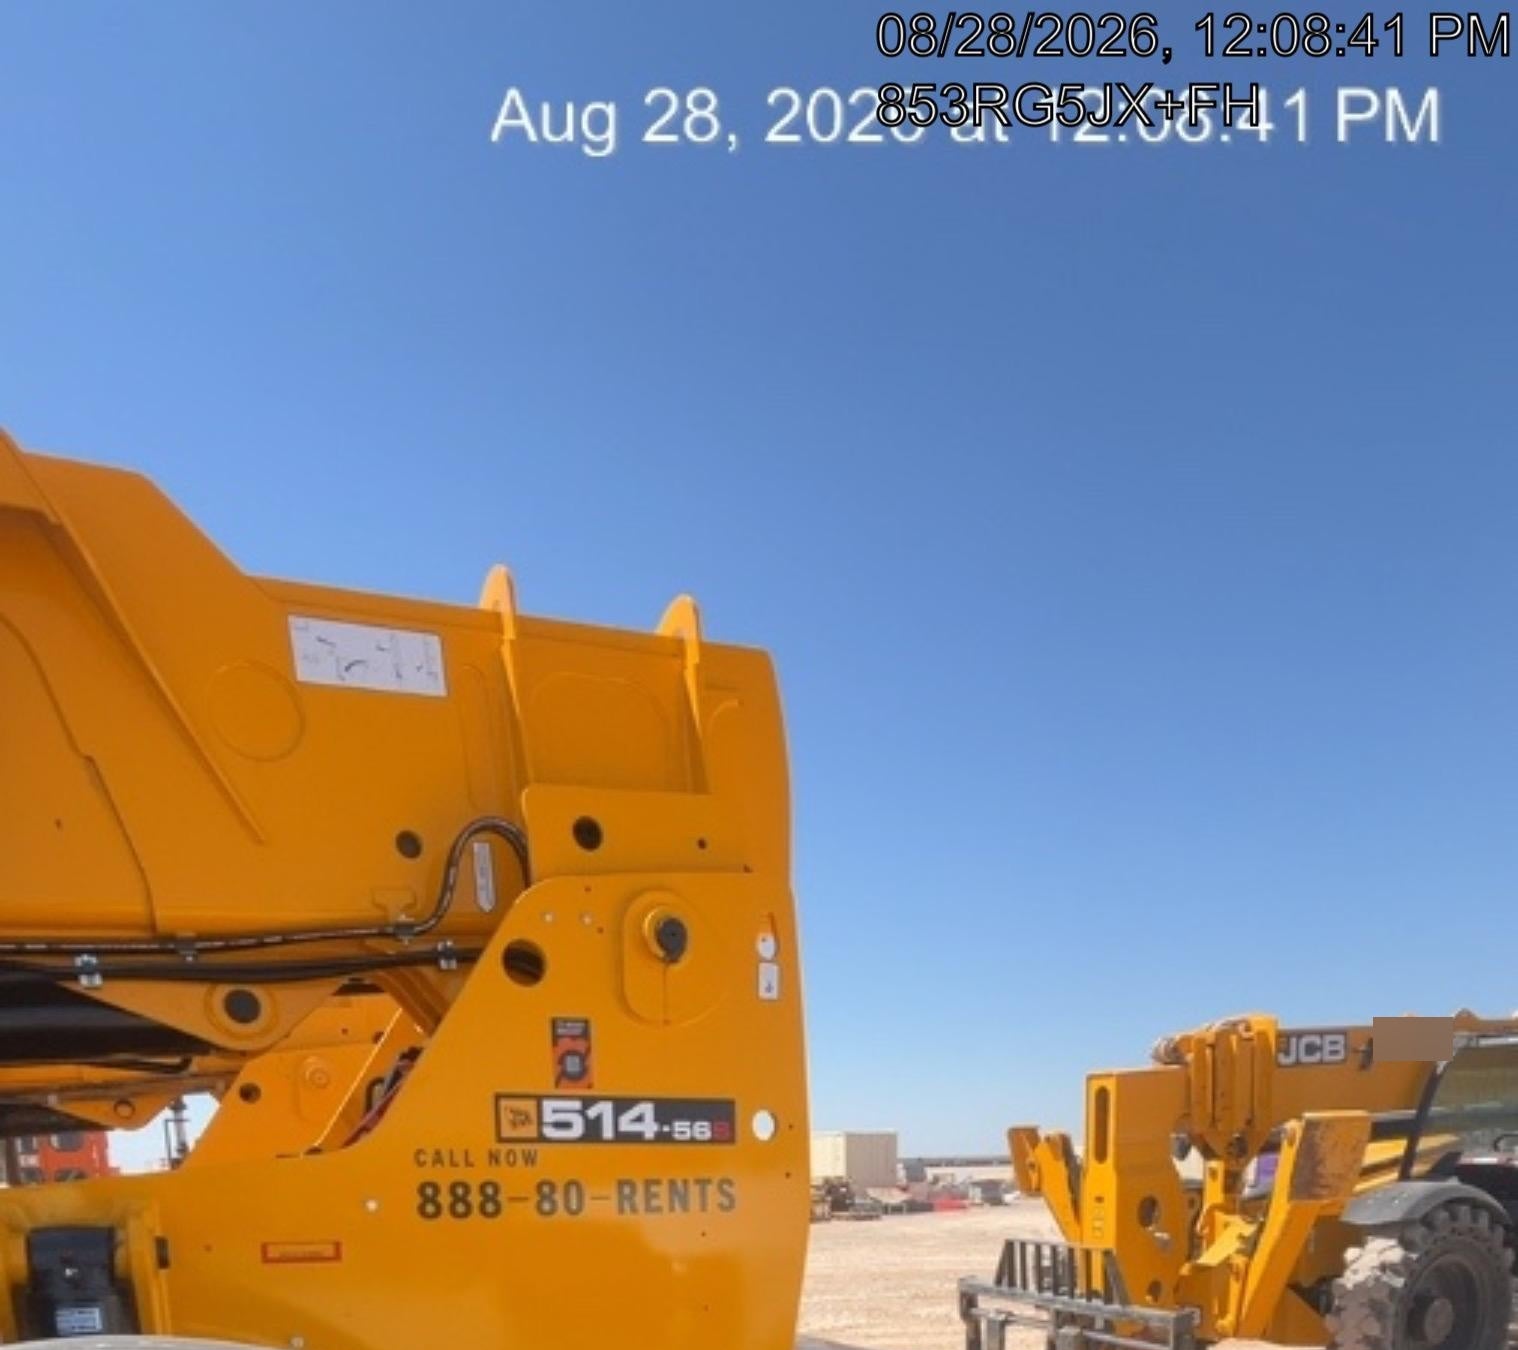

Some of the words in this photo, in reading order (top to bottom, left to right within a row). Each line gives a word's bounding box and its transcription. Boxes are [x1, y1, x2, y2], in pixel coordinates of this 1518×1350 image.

[1277, 1034, 1345, 1065] JCB
[414, 1149, 475, 1168] CALL
[488, 1149, 539, 1168] NOW
[416, 1178, 736, 1220] 888-80-RENTS
